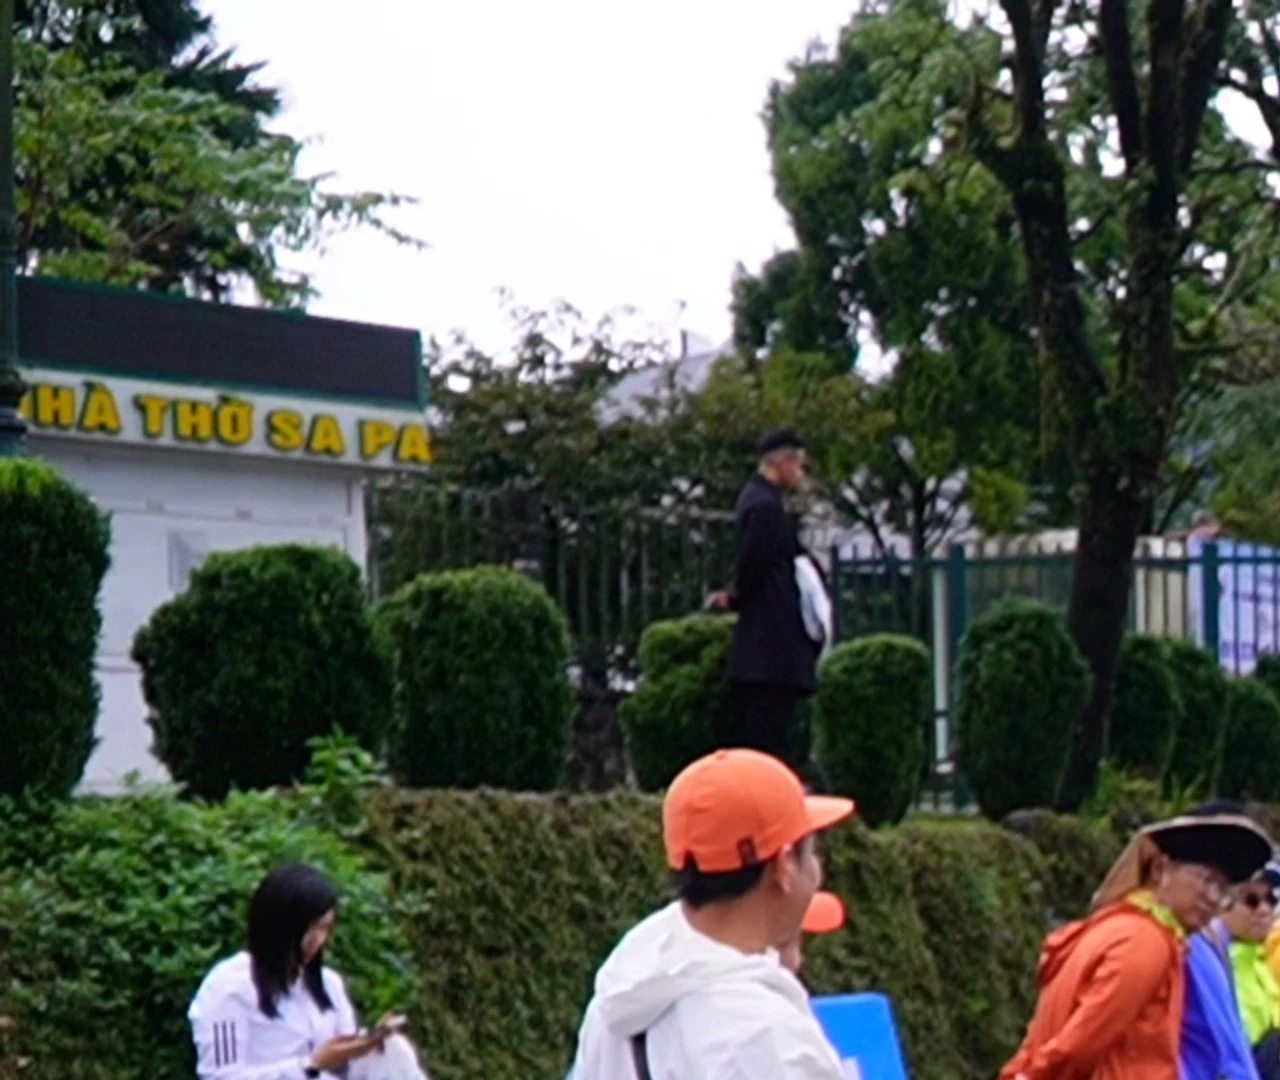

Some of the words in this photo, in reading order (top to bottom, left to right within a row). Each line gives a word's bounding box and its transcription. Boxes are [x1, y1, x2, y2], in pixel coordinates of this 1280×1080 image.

[18, 381, 122, 435] HÀ
[133, 392, 253, 446] THỜ
[265, 407, 345, 456] SA
[357, 418, 433, 463] PA
